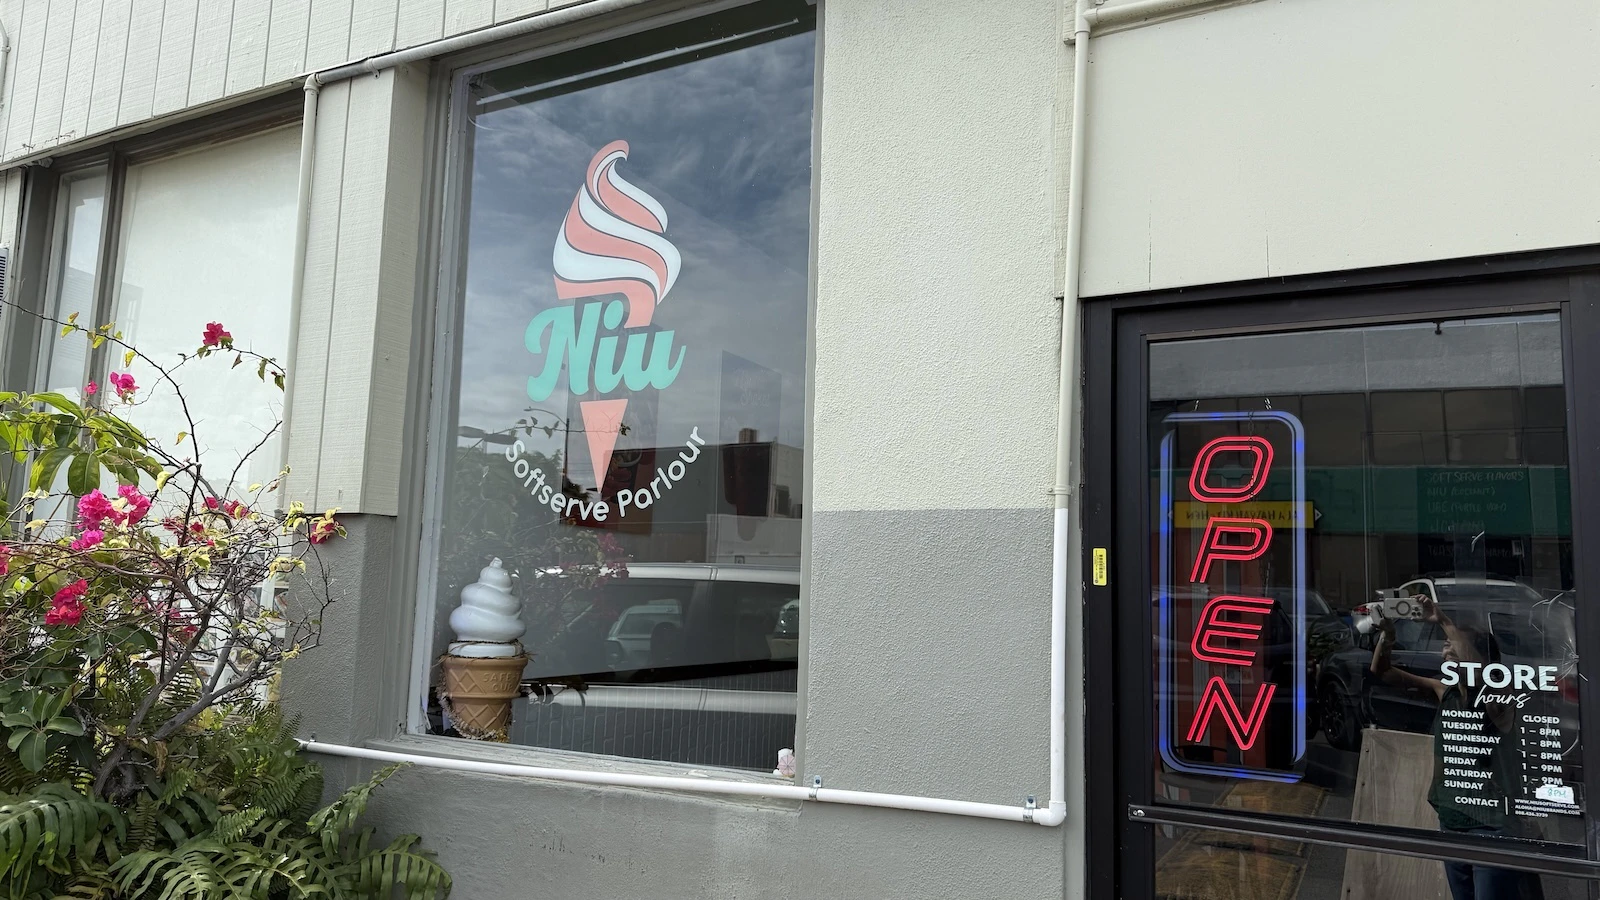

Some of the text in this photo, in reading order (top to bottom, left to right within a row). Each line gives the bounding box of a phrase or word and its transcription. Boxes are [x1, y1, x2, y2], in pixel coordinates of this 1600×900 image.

[524, 300, 687, 402] Niu
[505, 426, 706, 523] Softserve Parlour
[1453, 471, 1483, 481] SERVE
[1187, 436, 1277, 751] OPEN
[1440, 661, 1559, 692] STORE
[1474, 684, 1531, 708] hours
[1442, 710, 1560, 724] MONDAY CLOSED
[1442, 721, 1484, 731] TUESDAY
[1539, 728, 1561, 737] 8PM
[1442, 733, 1501, 744] WEDNESDAY
[1540, 740, 1562, 749] 8PM
[1443, 744, 1493, 755] THURSDAY
[1540, 752, 1562, 761] 8PM
[1443, 756, 1477, 766] FRIDAY
[1541, 764, 1563, 773] 9PM
[1443, 768, 1493, 779] SATURDAY
[1541, 776, 1563, 785] 9PM
[1444, 780, 1484, 790] SUNDAY
[1454, 796, 1499, 807] CONTACT
